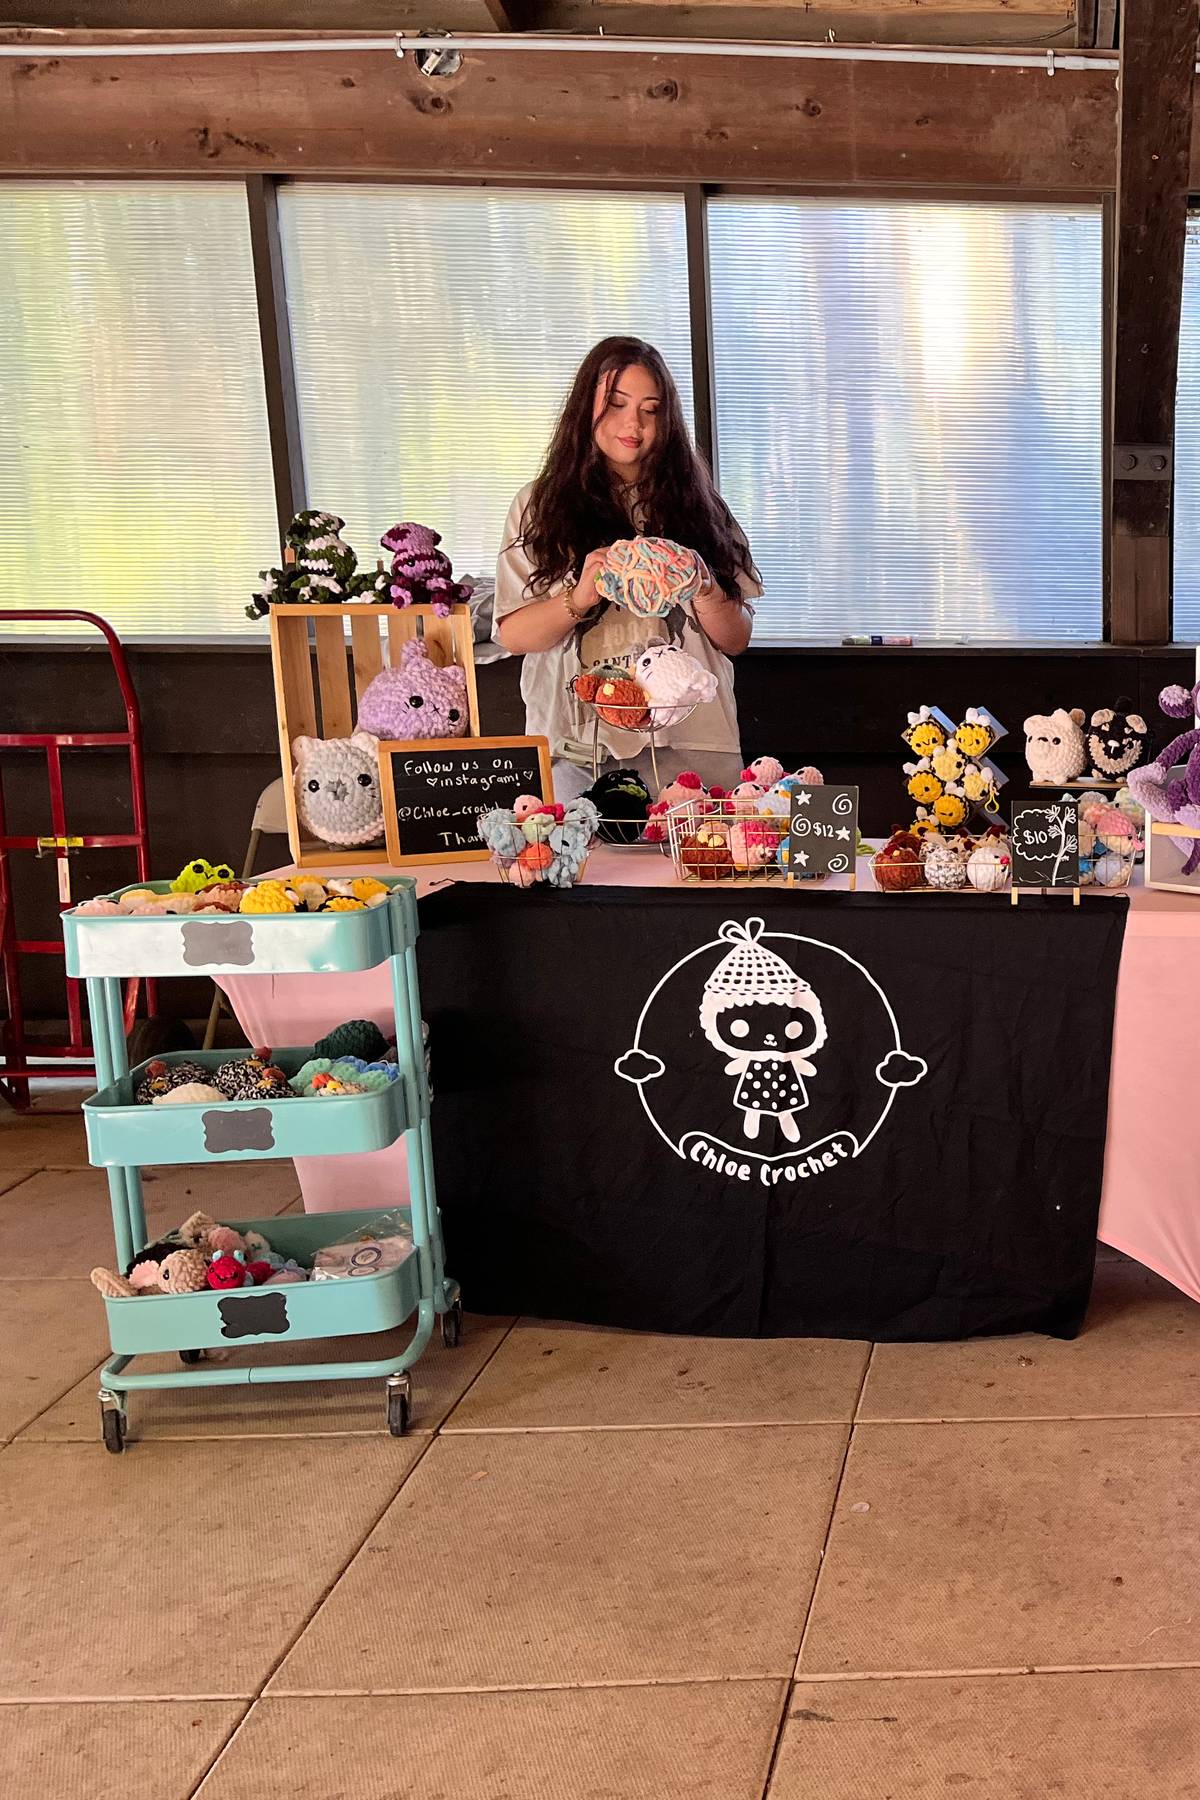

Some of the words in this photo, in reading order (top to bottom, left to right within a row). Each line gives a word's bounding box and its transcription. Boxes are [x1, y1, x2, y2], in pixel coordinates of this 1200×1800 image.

[404, 760, 454, 776] Follow
[461, 760, 479, 771] us
[492, 758, 513, 770] on
[440, 773, 521, 791] instagram!
[812, 821, 835, 838] $12
[1023, 829, 1048, 845] $10
[437, 831, 484, 847] Than
[689, 1140, 751, 1181] Chloe
[759, 1142, 848, 1187] Crochet
